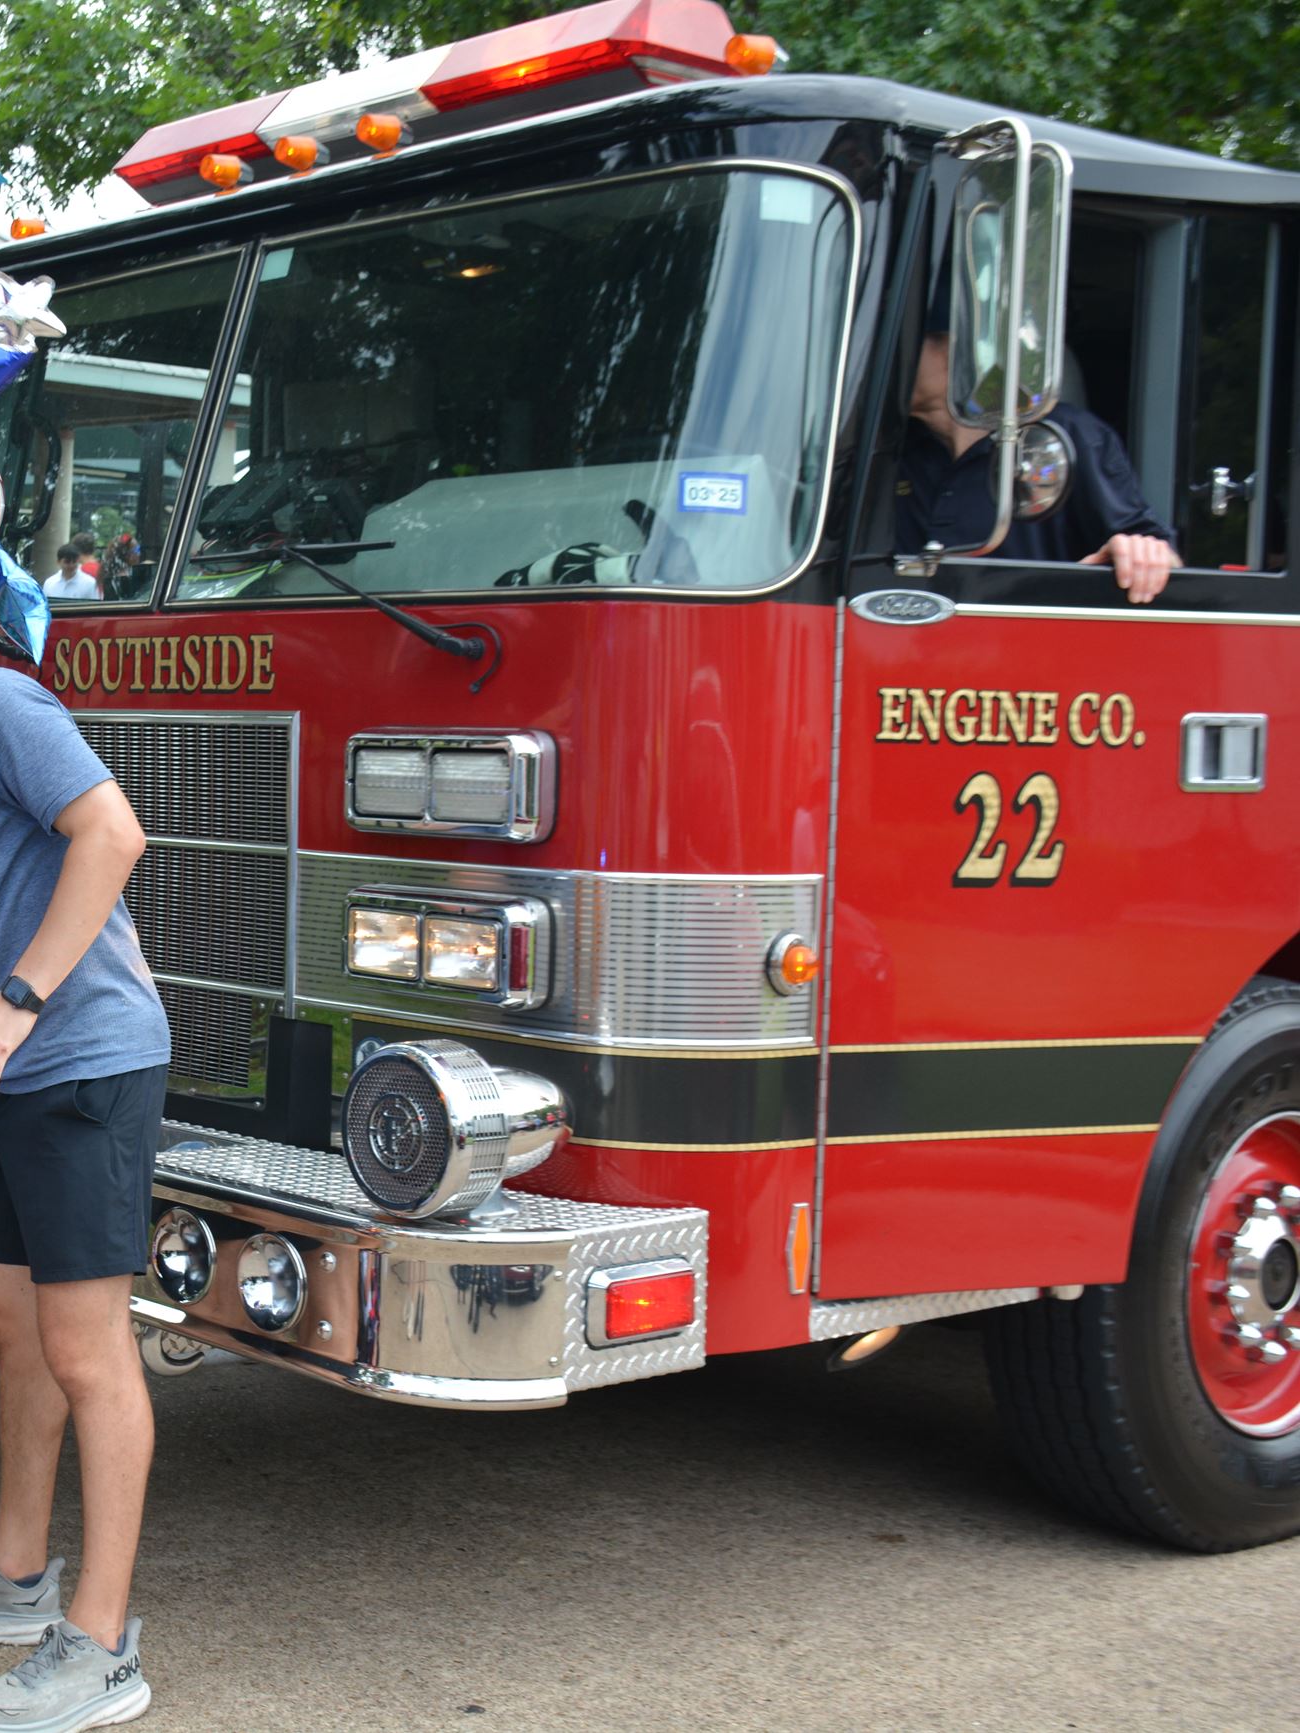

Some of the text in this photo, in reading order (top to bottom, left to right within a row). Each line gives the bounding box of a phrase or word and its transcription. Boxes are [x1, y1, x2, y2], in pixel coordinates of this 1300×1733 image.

[688, 486, 740, 503] 03 25
[54, 634, 276, 694] SOUTHSIDE
[875, 688, 1146, 748] ENGINE CO.
[952, 772, 1065, 887] 22
[105, 1654, 141, 1691] HOKA
